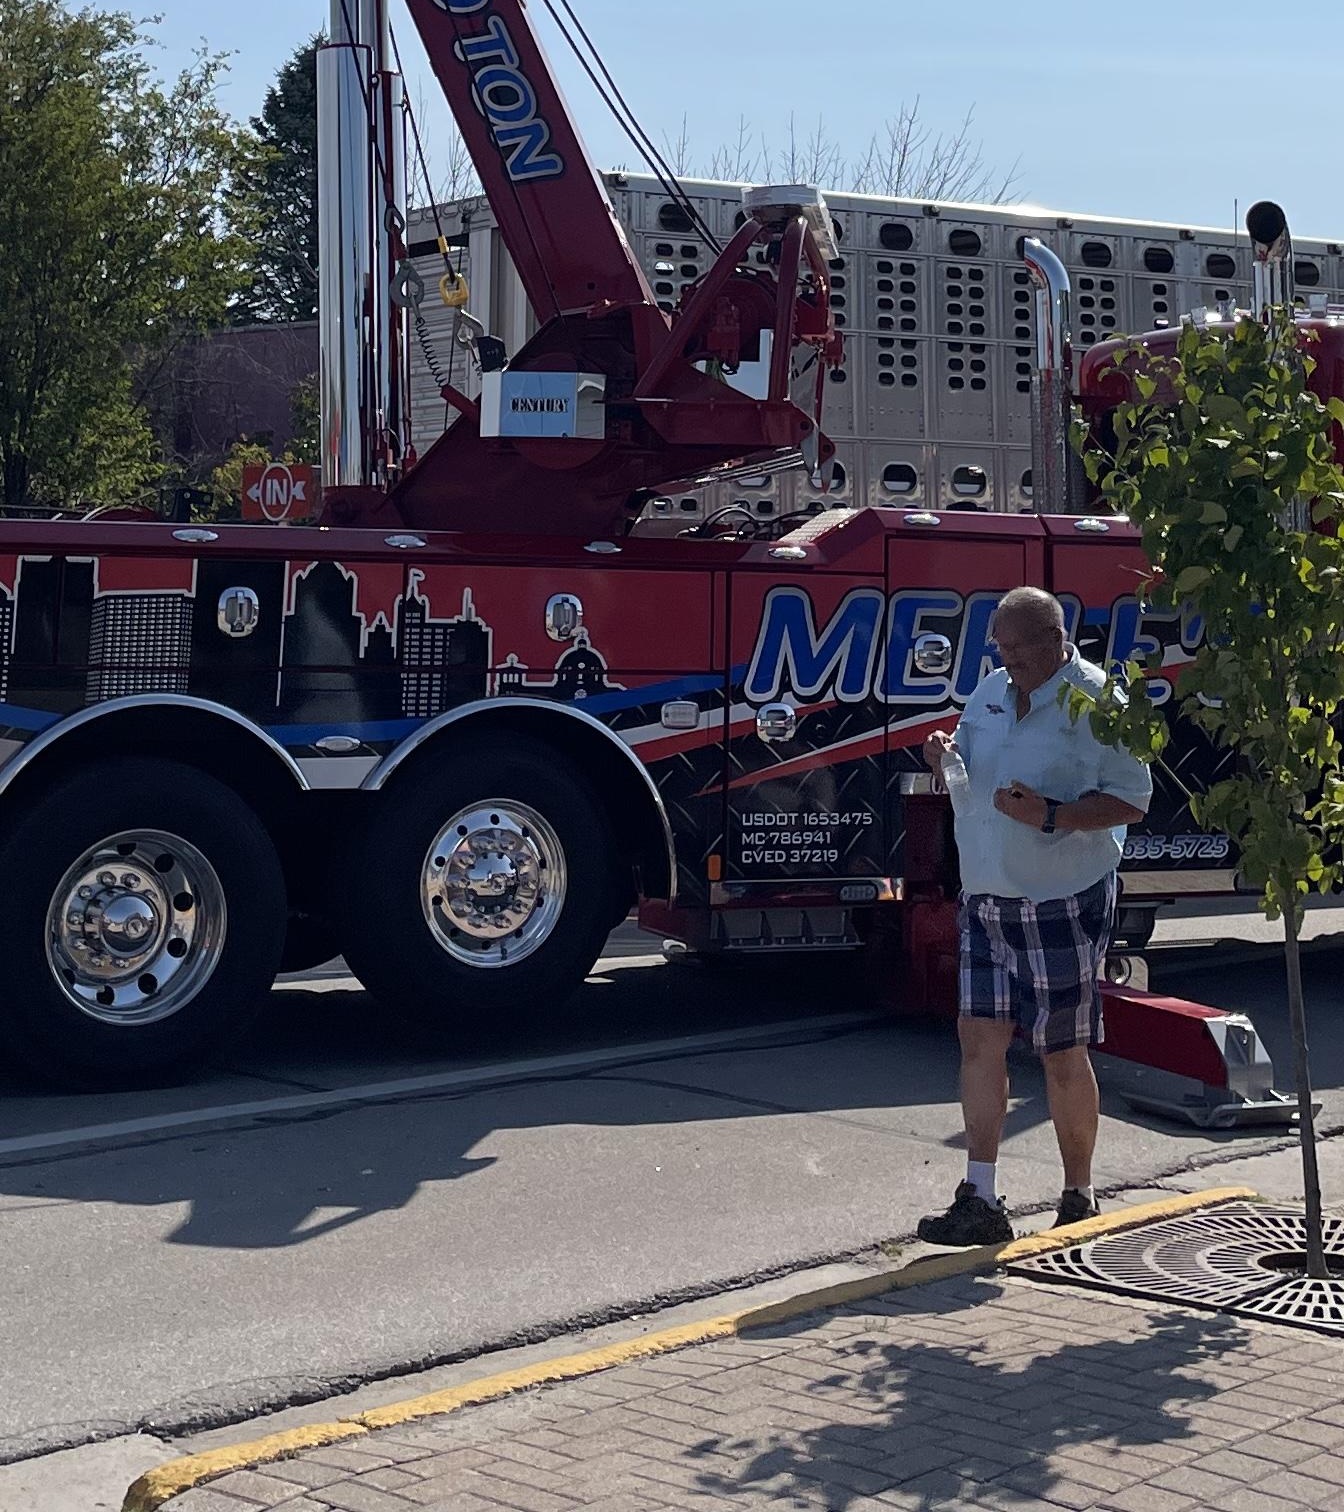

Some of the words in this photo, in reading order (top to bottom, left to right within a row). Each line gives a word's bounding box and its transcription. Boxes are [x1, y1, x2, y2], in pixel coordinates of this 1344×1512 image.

[454, 15, 564, 182] TON
[511, 398, 568, 413] CENTURY
[265, 479, 288, 505] IN
[742, 813, 799, 826] USDOT
[803, 812, 873, 825] 1653475
[742, 832, 765, 845] MC
[769, 831, 831, 845] 786941
[742, 850, 786, 863] CVED
[790, 849, 838, 863] 37219
